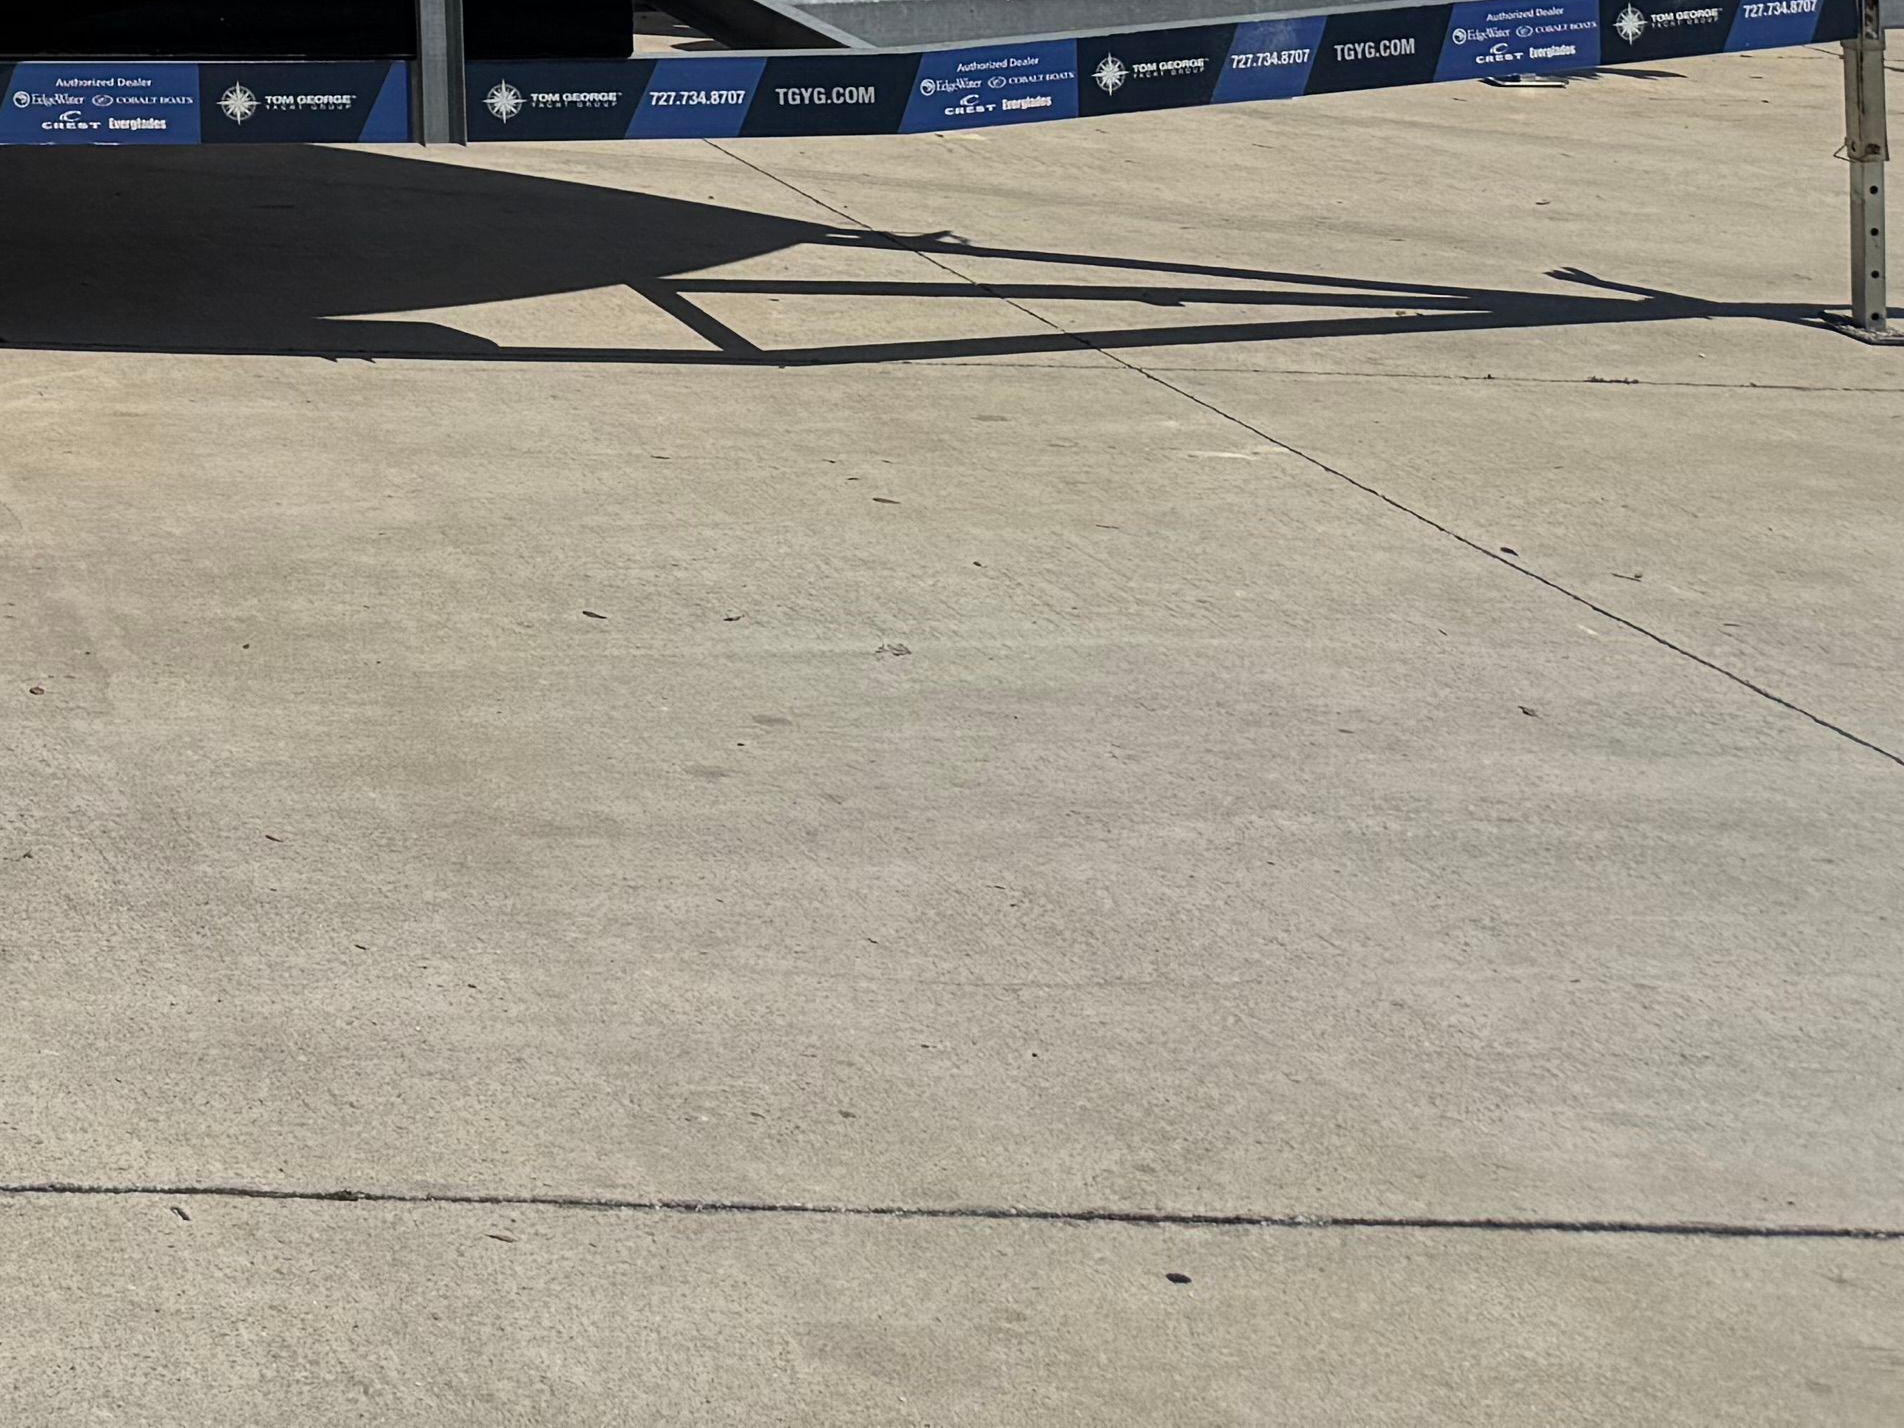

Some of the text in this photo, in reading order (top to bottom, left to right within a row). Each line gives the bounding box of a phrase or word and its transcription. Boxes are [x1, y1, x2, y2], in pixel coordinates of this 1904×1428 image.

[1486, 6, 1565, 22] Authorized Dealer
[1651, 12, 1674, 23] TOM
[1333, 37, 1415, 61] TGYG.COM
[956, 56, 1040, 73] Authorized Dealer
[1230, 48, 1310, 69] 727.734.8707
[1132, 62, 1157, 73] TOM
[55, 78, 152, 87] Authorized Dealer
[265, 95, 294, 105] TOM
[531, 93, 560, 102] TOM
[649, 90, 746, 106] 727.734.8707
[775, 86, 875, 106] TGYG.COM
